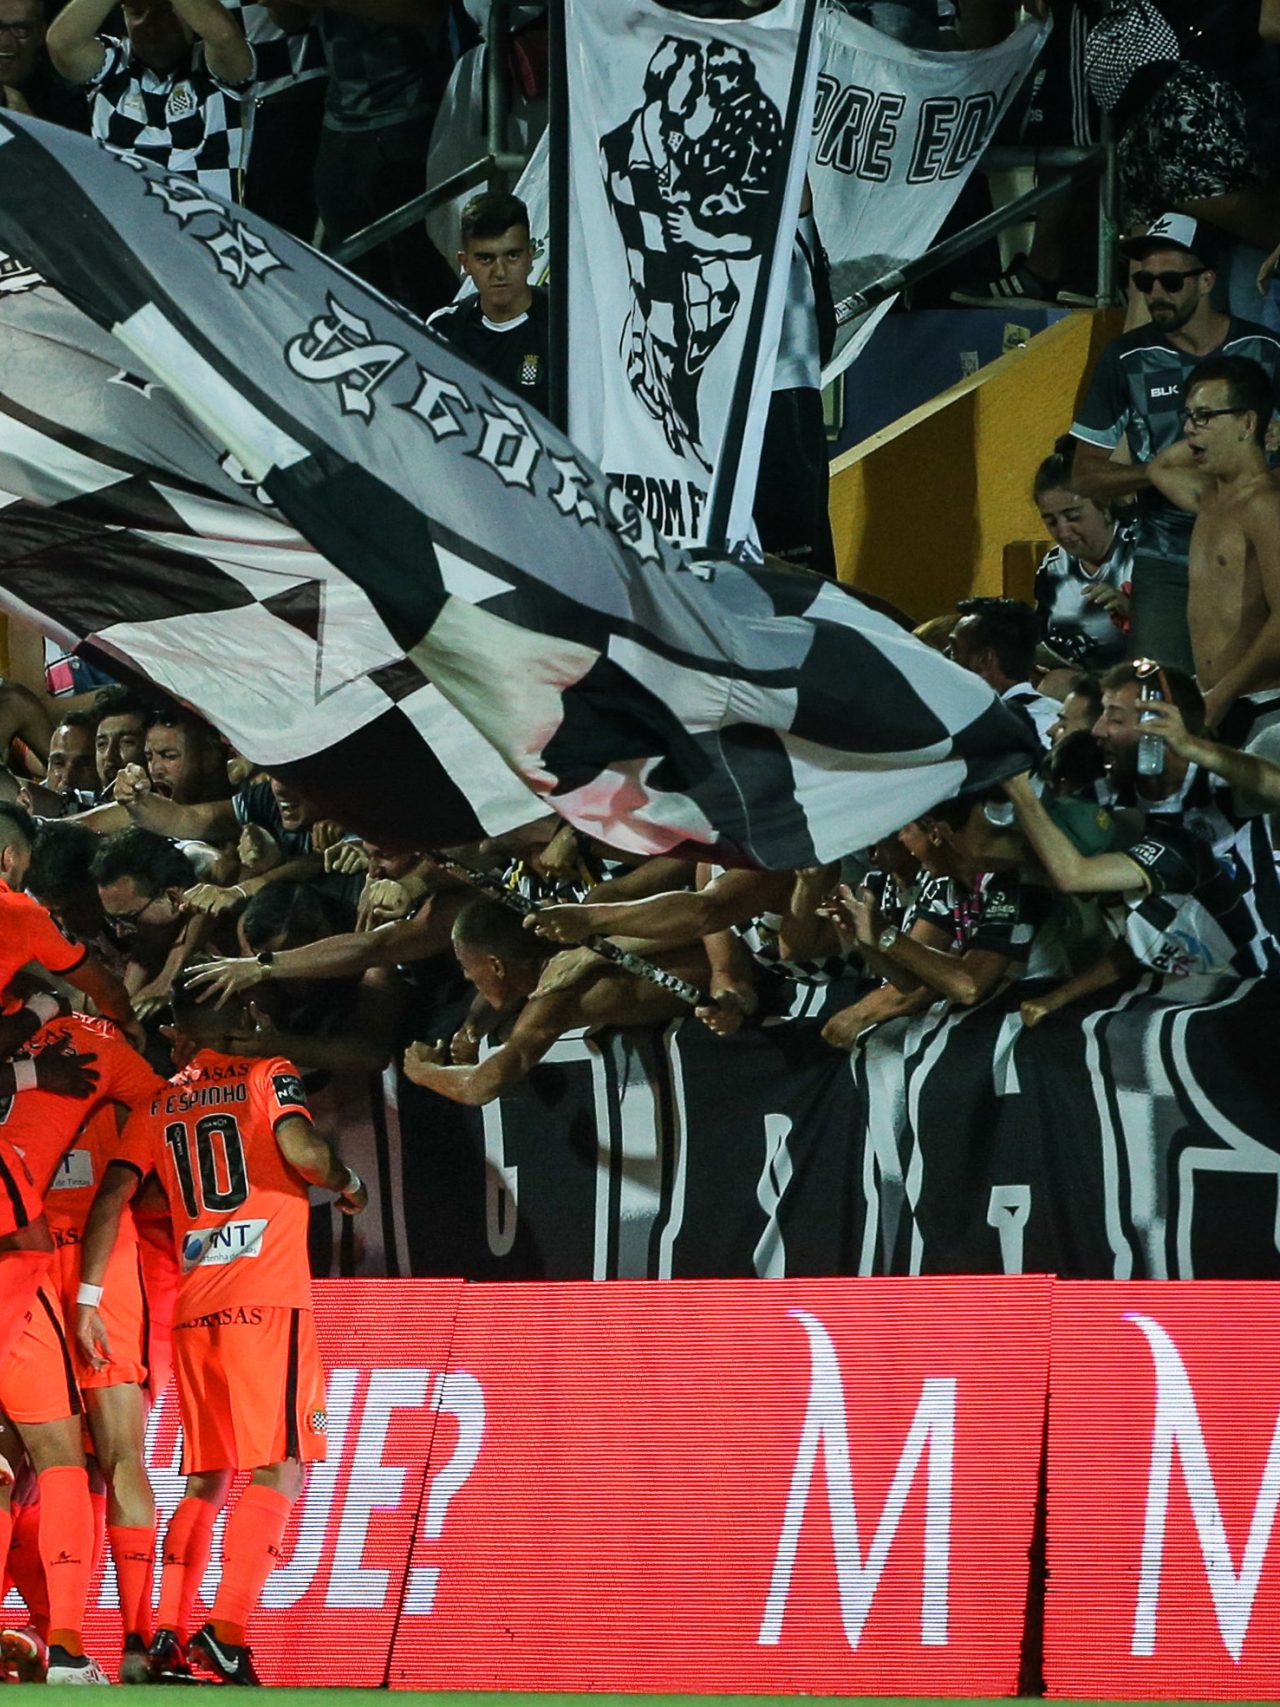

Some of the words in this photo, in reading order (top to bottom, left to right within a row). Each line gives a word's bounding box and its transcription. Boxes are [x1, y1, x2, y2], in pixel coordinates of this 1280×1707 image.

[1150, 384, 1180, 398] BLK
[165, 1082, 249, 1115] ESPINHO
[164, 1111, 250, 1220] 10
[756, 1308, 958, 1651] M
